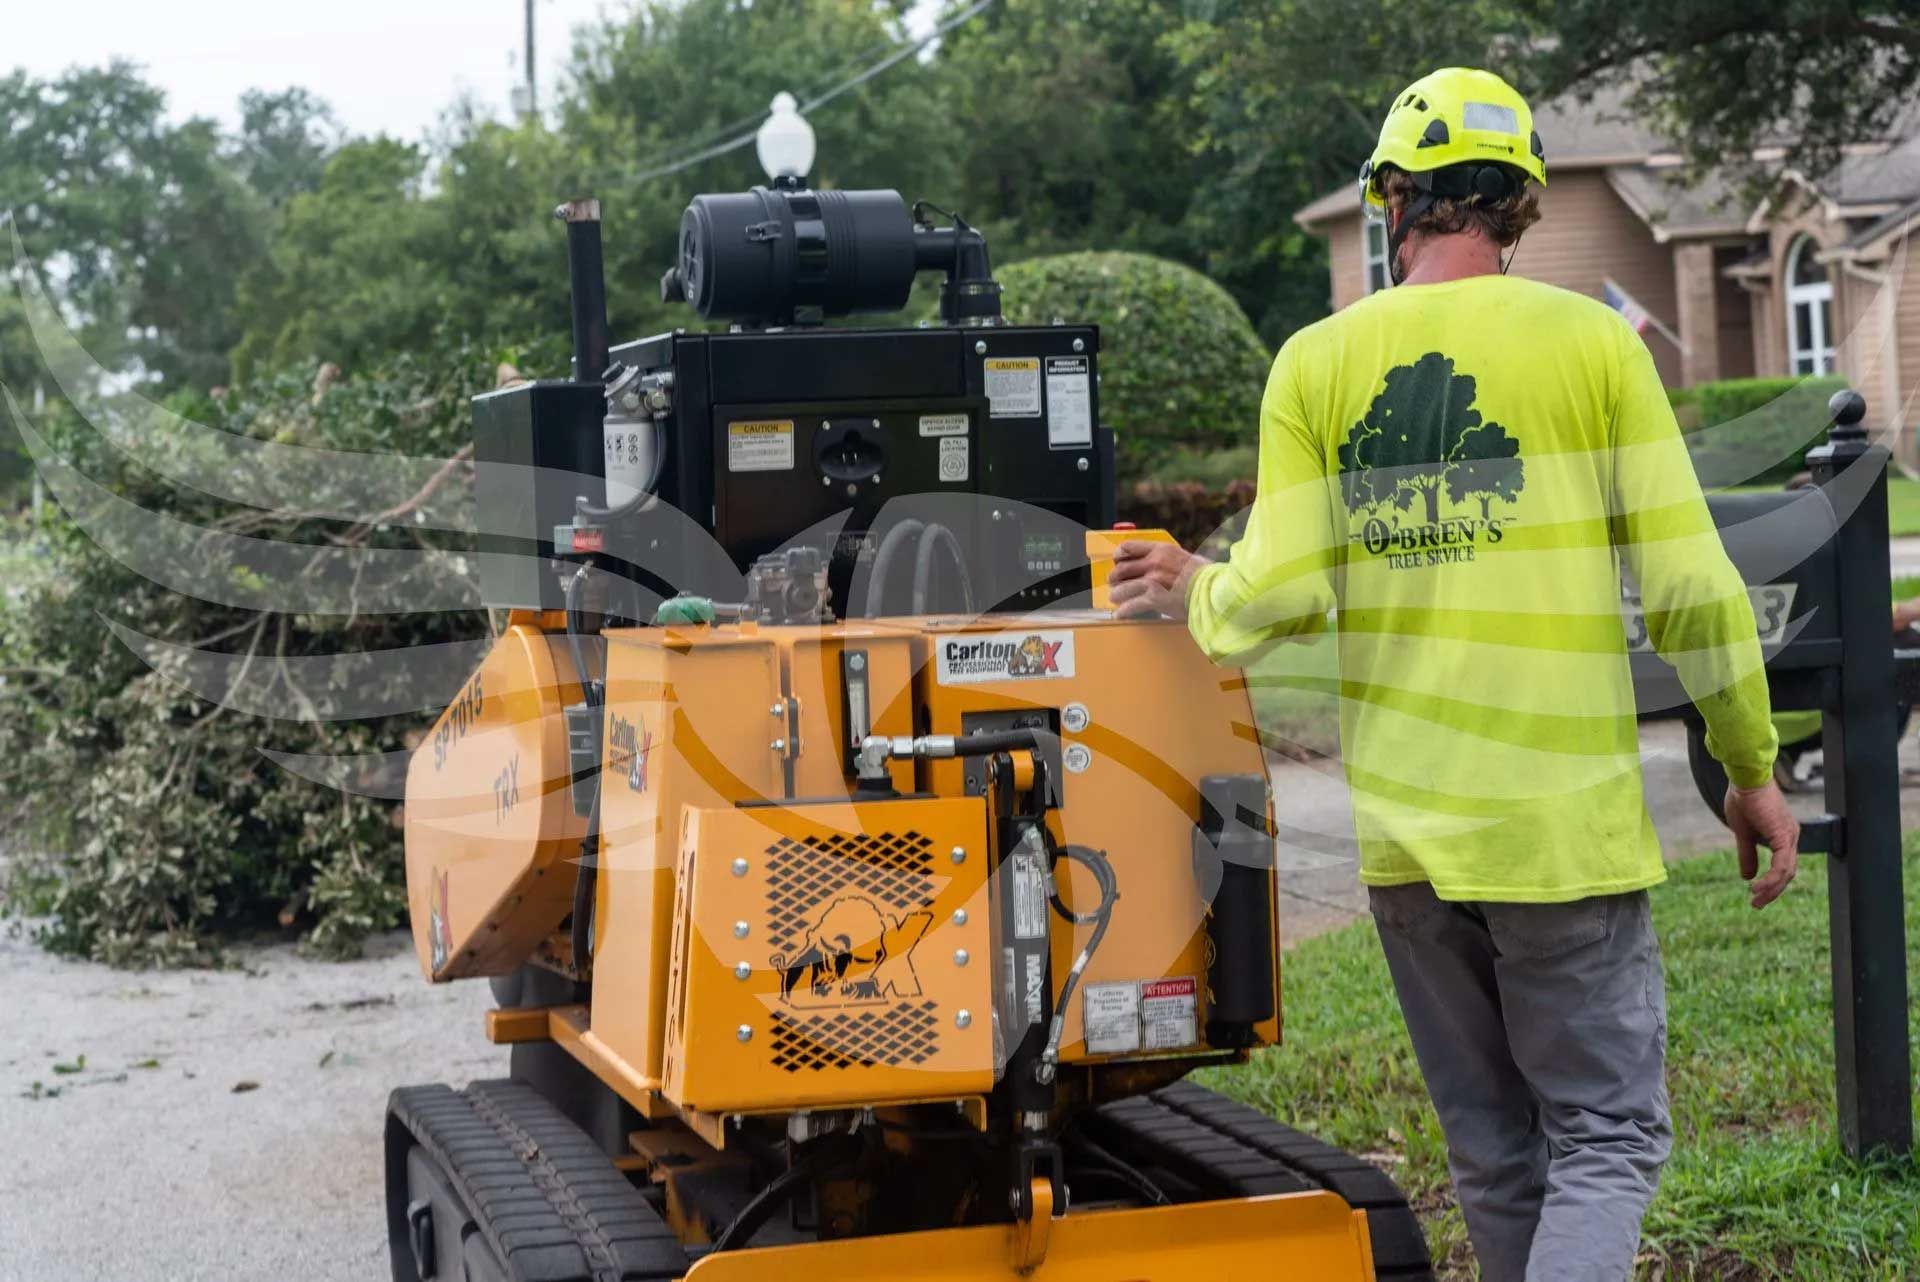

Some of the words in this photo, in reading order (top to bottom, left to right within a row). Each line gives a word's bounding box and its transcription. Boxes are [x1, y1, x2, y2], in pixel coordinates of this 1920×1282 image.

[995, 360, 1029, 370] CAUTION
[743, 423, 779, 434] CAUTION
[1385, 550, 1423, 570] TREE
[945, 641, 1017, 661] Carlton
[434, 672, 483, 772] SP7015
[494, 752, 520, 826] TRX
[1146, 983, 1191, 997] ATTENTION
